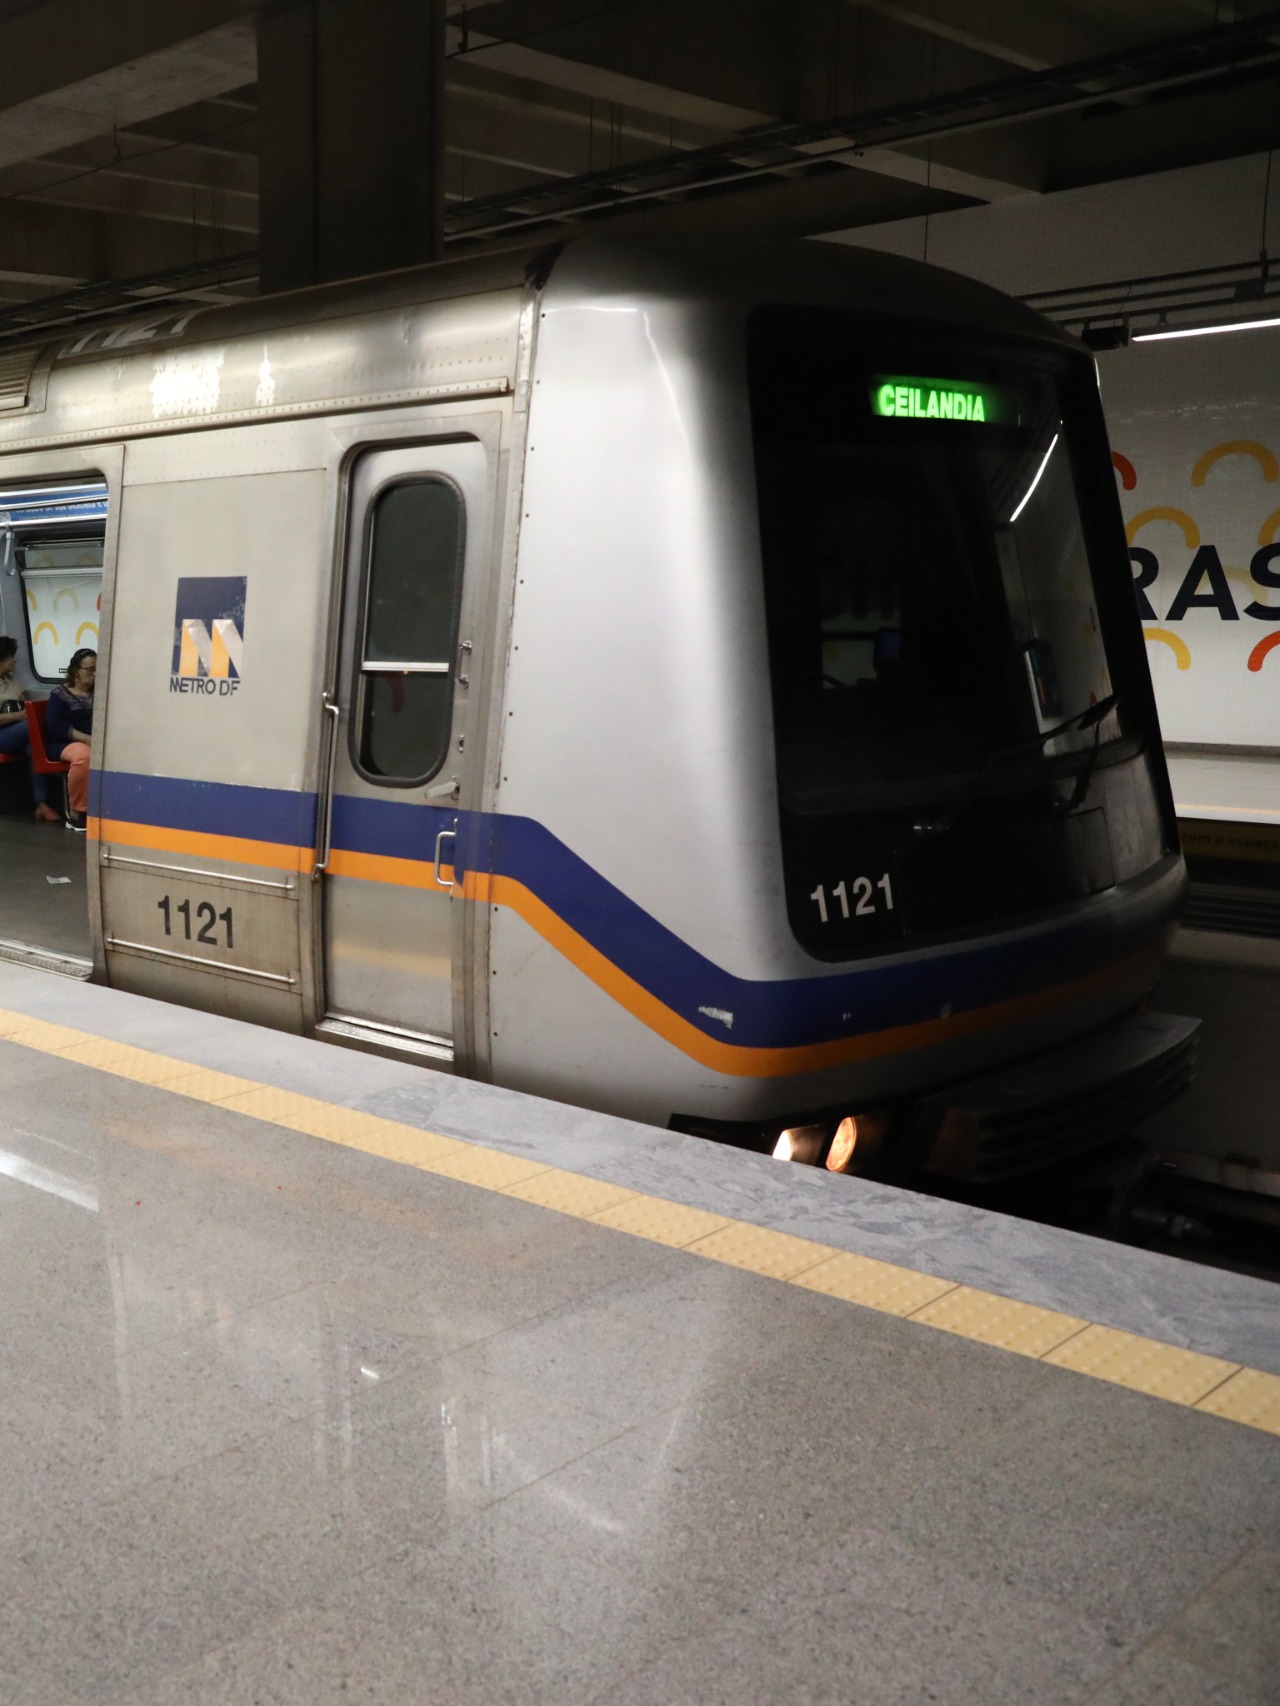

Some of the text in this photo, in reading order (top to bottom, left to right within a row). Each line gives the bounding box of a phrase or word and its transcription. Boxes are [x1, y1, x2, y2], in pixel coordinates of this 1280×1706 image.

[877, 384, 986, 422] CEILANDIA
[169, 676, 241, 697] METRO DF
[810, 872, 894, 923] 1121
[157, 894, 234, 949] 1121
